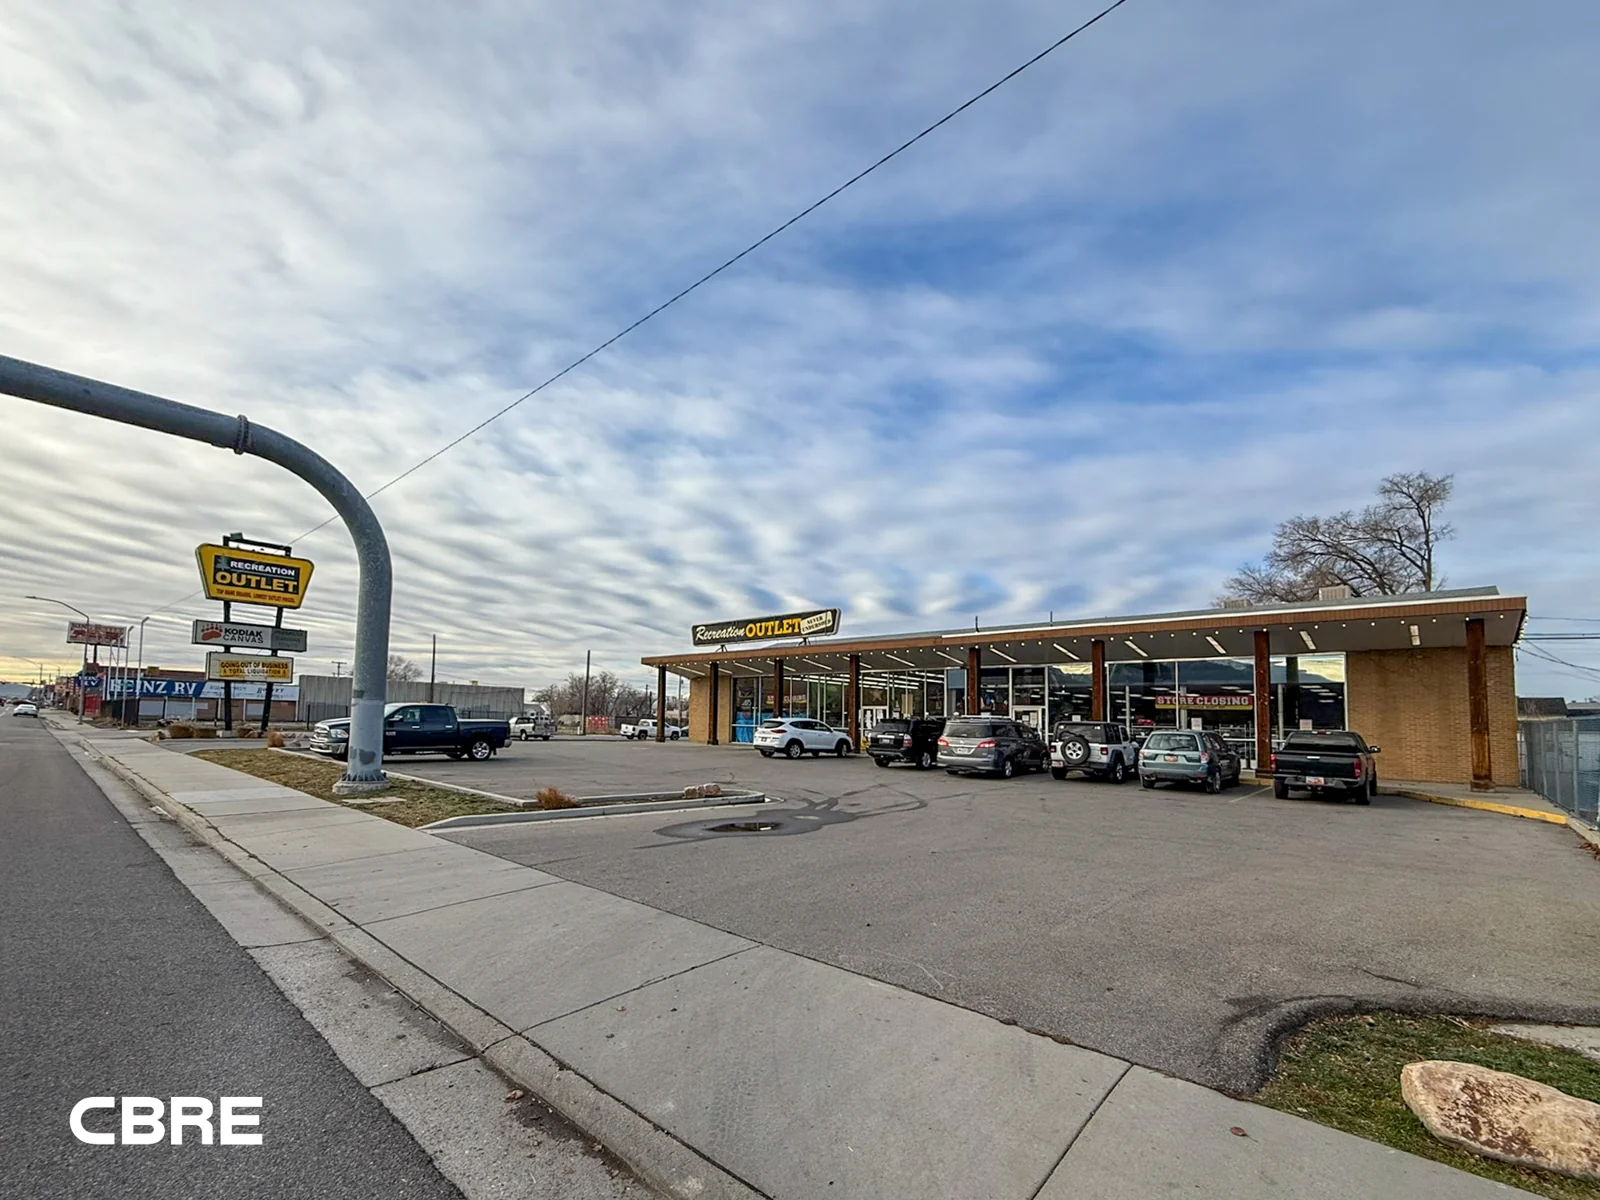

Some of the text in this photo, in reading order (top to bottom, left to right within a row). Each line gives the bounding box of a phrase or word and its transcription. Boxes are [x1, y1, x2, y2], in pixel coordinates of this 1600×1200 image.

[230, 560, 295, 576] RECREATION
[215, 571, 297, 593] OUTLET
[806, 615, 823, 625] NEVER
[224, 627, 263, 638] KODIAK
[695, 617, 803, 641] Recreation OUTLET
[222, 634, 264, 644] CANVAS
[220, 661, 288, 670] GOING OUT OF BUSINESS
[247, 668, 281, 676] LIQUIDATION
[173, 681, 198, 697] RV
[1156, 696, 1249, 706] STORE CLOSING
